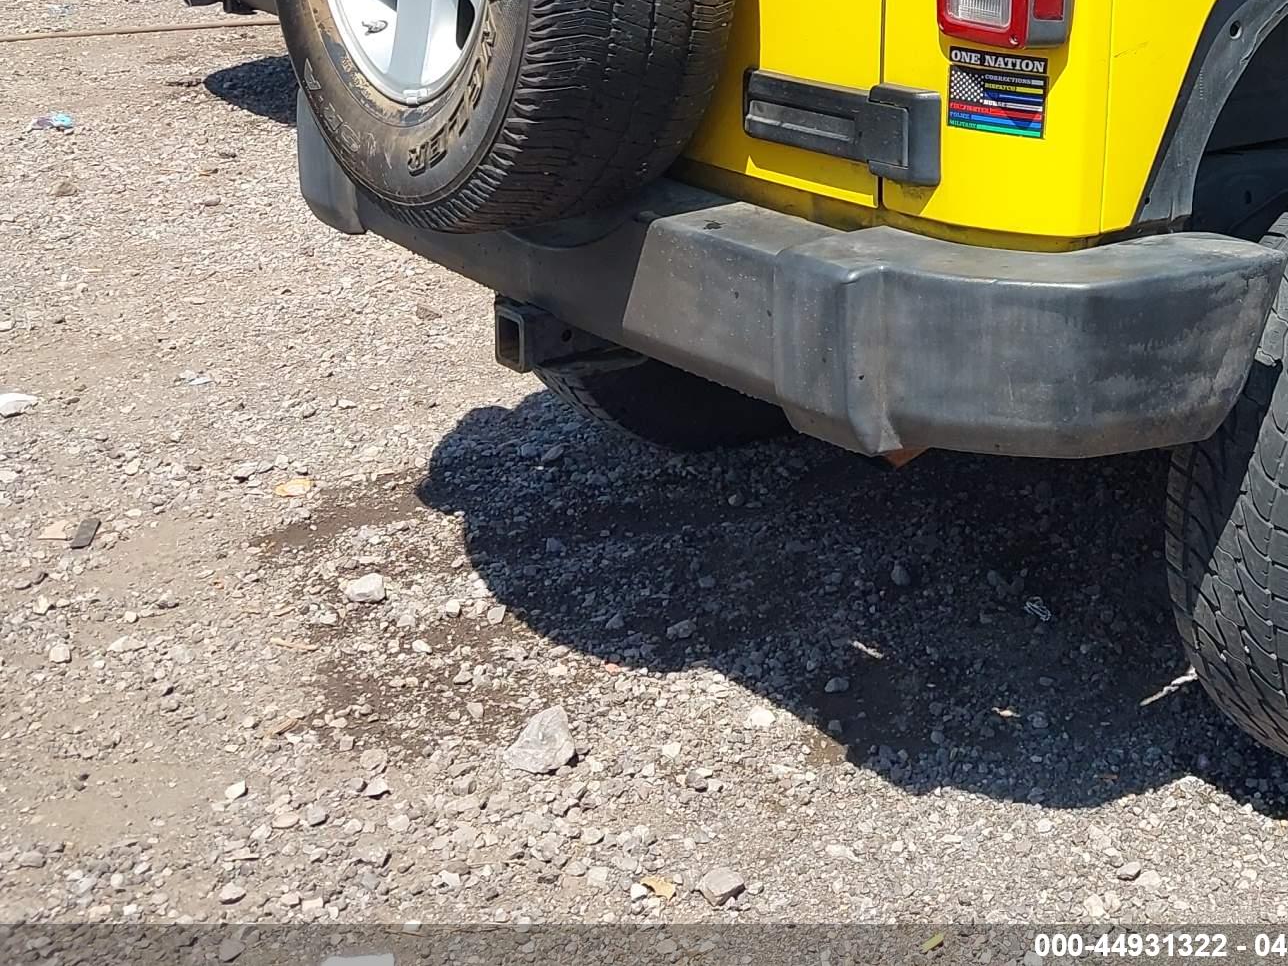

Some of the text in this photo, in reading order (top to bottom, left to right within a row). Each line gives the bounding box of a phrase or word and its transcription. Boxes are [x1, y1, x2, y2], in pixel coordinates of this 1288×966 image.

[951, 49, 1045, 72] ONE NATION
[984, 73, 1032, 85] CORRECTIONS
